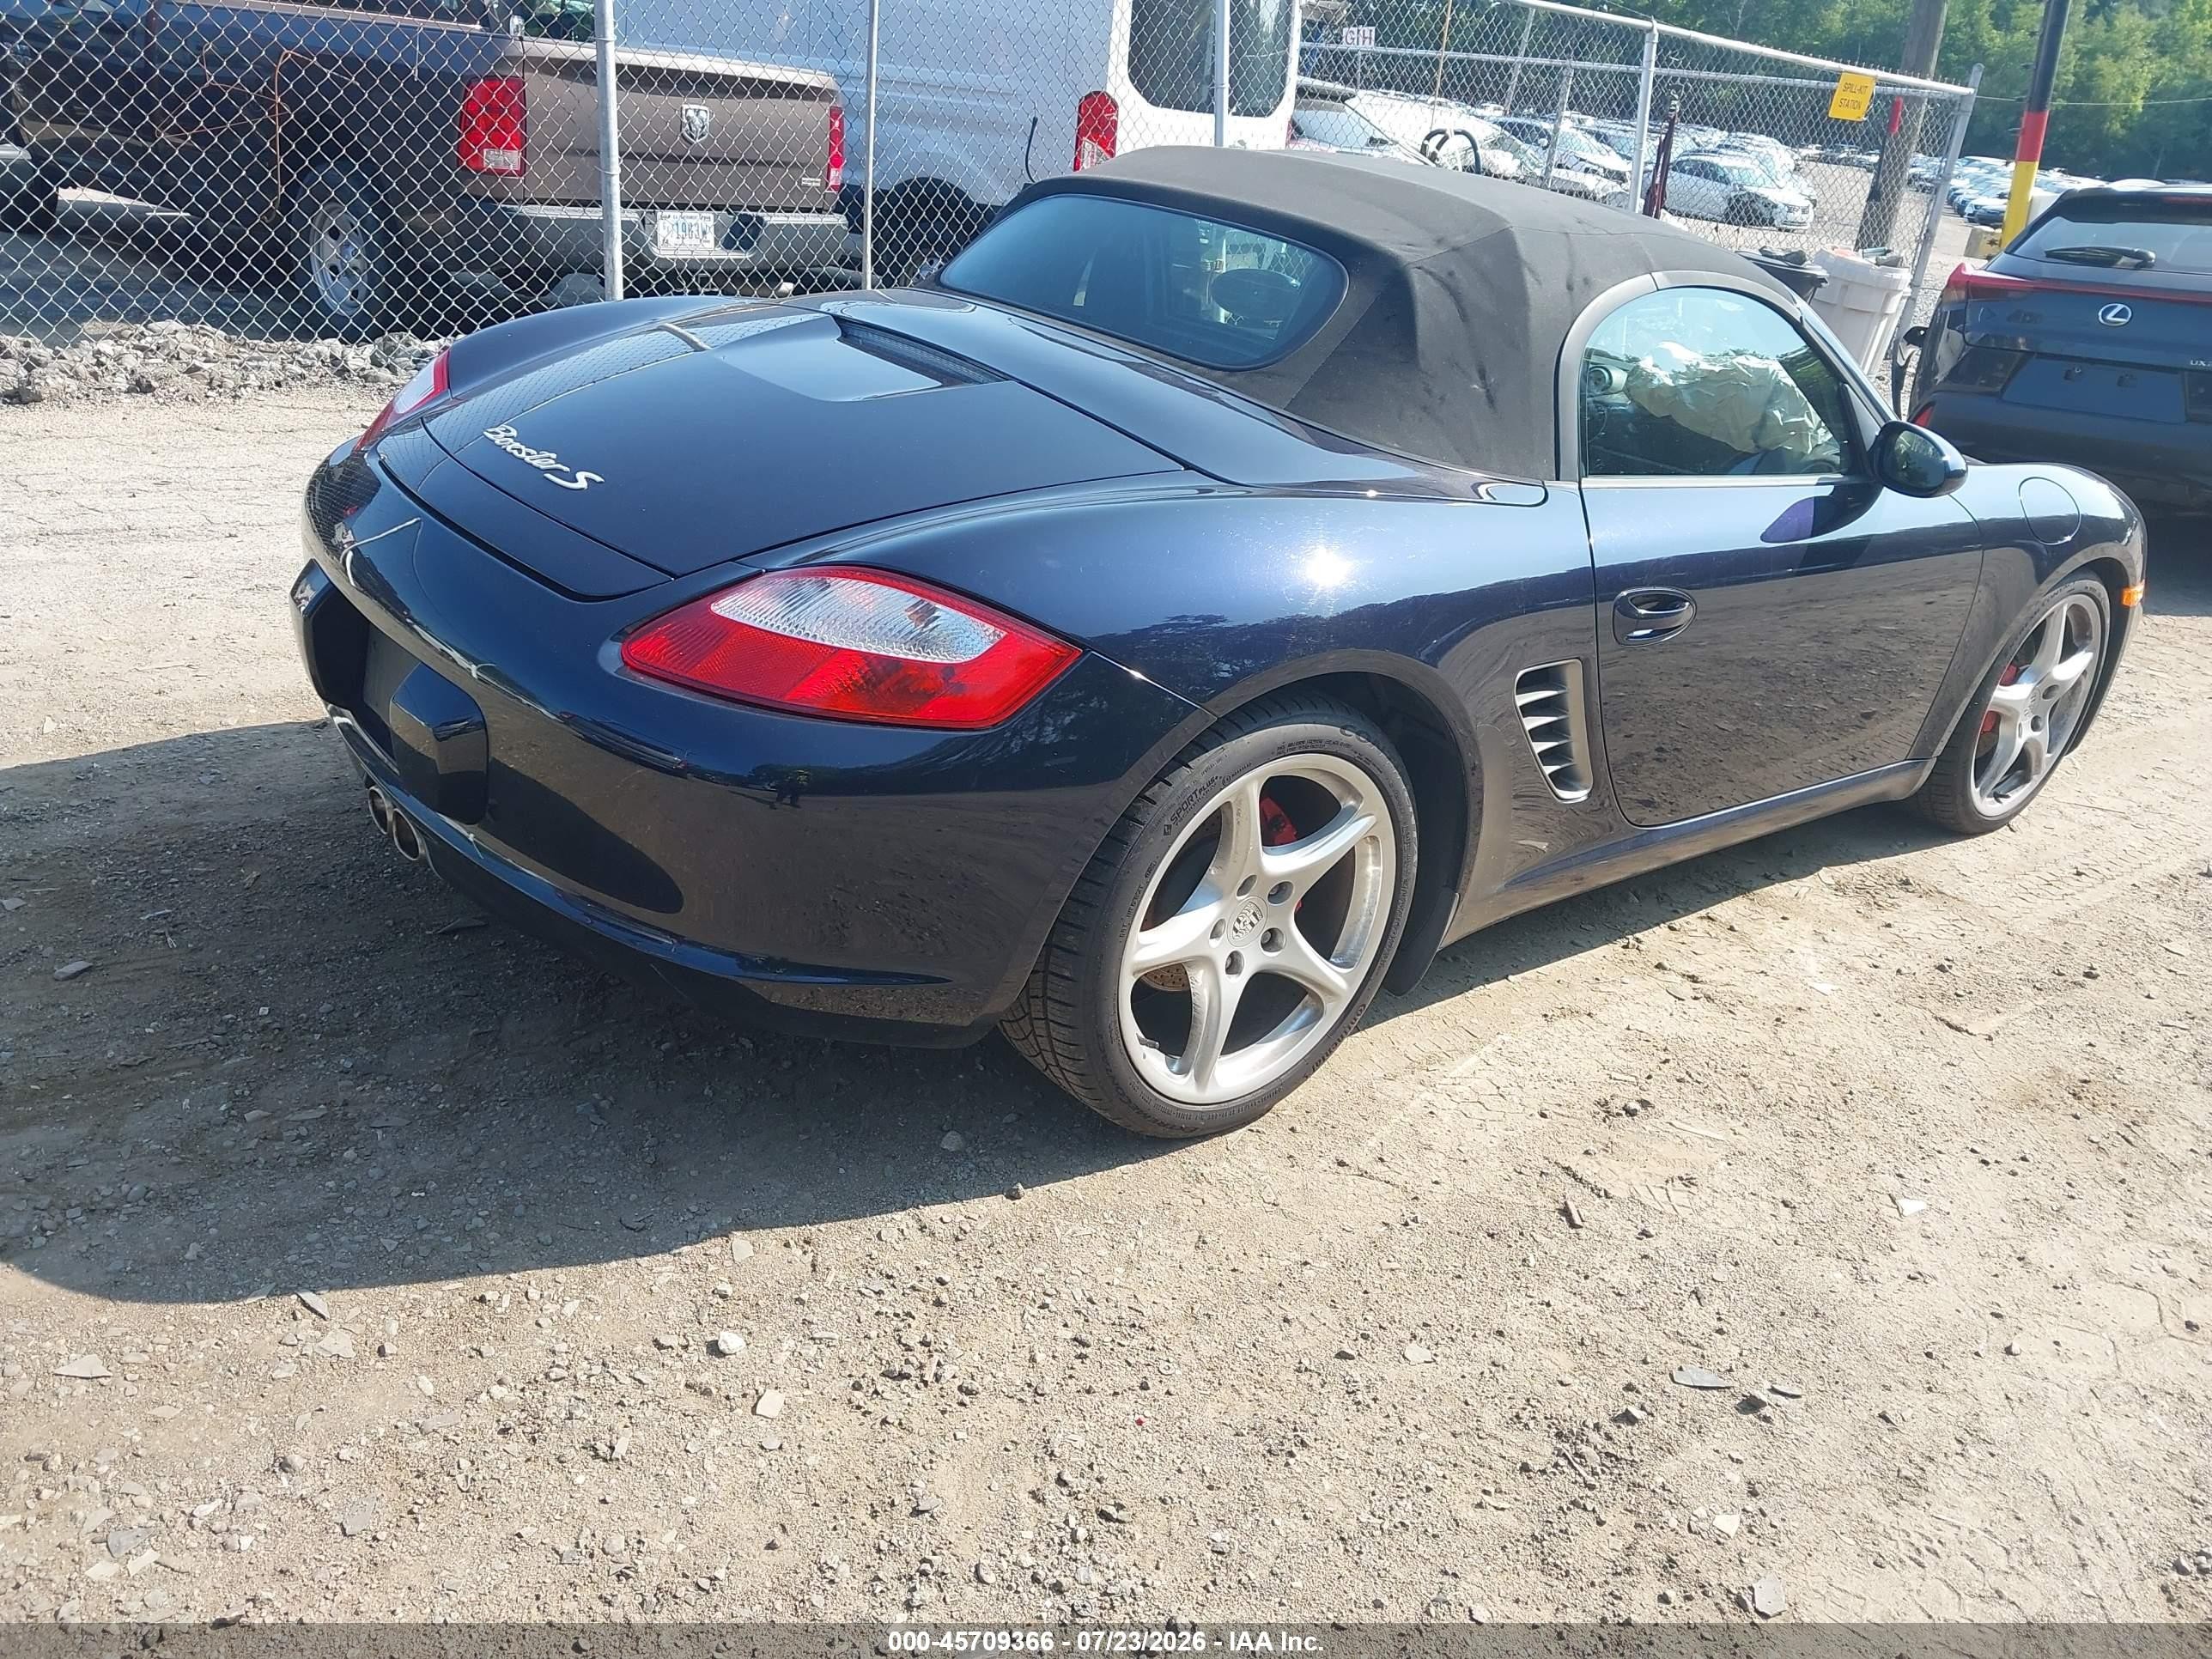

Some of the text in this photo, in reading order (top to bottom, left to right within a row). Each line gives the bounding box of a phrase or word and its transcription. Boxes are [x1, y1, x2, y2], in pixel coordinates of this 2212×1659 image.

[1838, 97, 1862, 111] STATION
[483, 424, 605, 490] Boxster S
